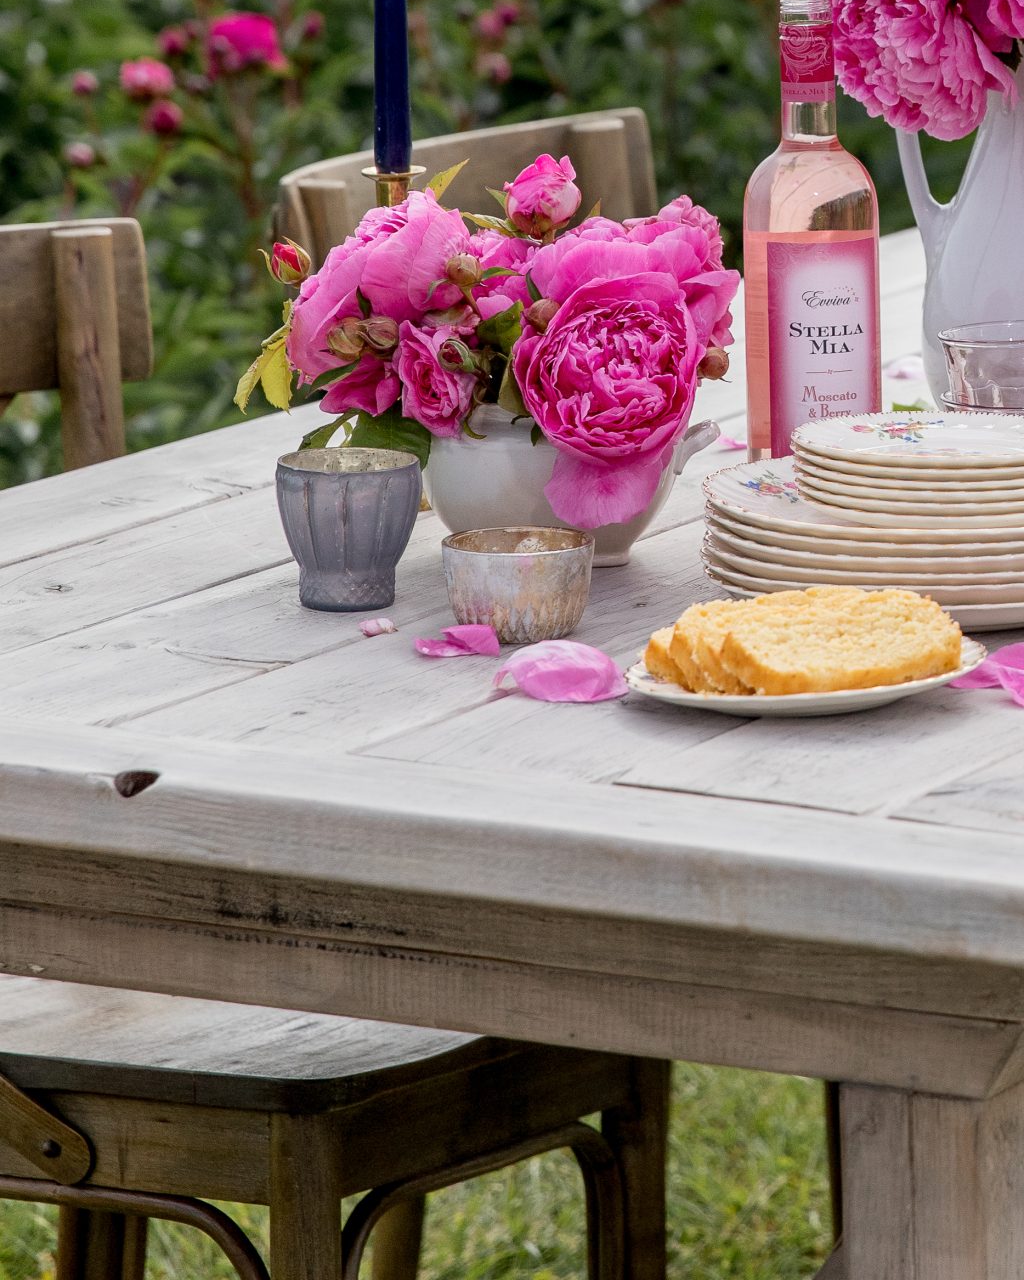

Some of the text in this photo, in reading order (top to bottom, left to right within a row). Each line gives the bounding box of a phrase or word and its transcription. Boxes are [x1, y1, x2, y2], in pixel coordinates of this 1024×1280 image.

[802, 291, 850, 308] Evviva
[789, 322, 864, 337] STELLA
[809, 339, 851, 354] MIA
[801, 386, 857, 402] Moscato
[808, 408, 817, 418] &
